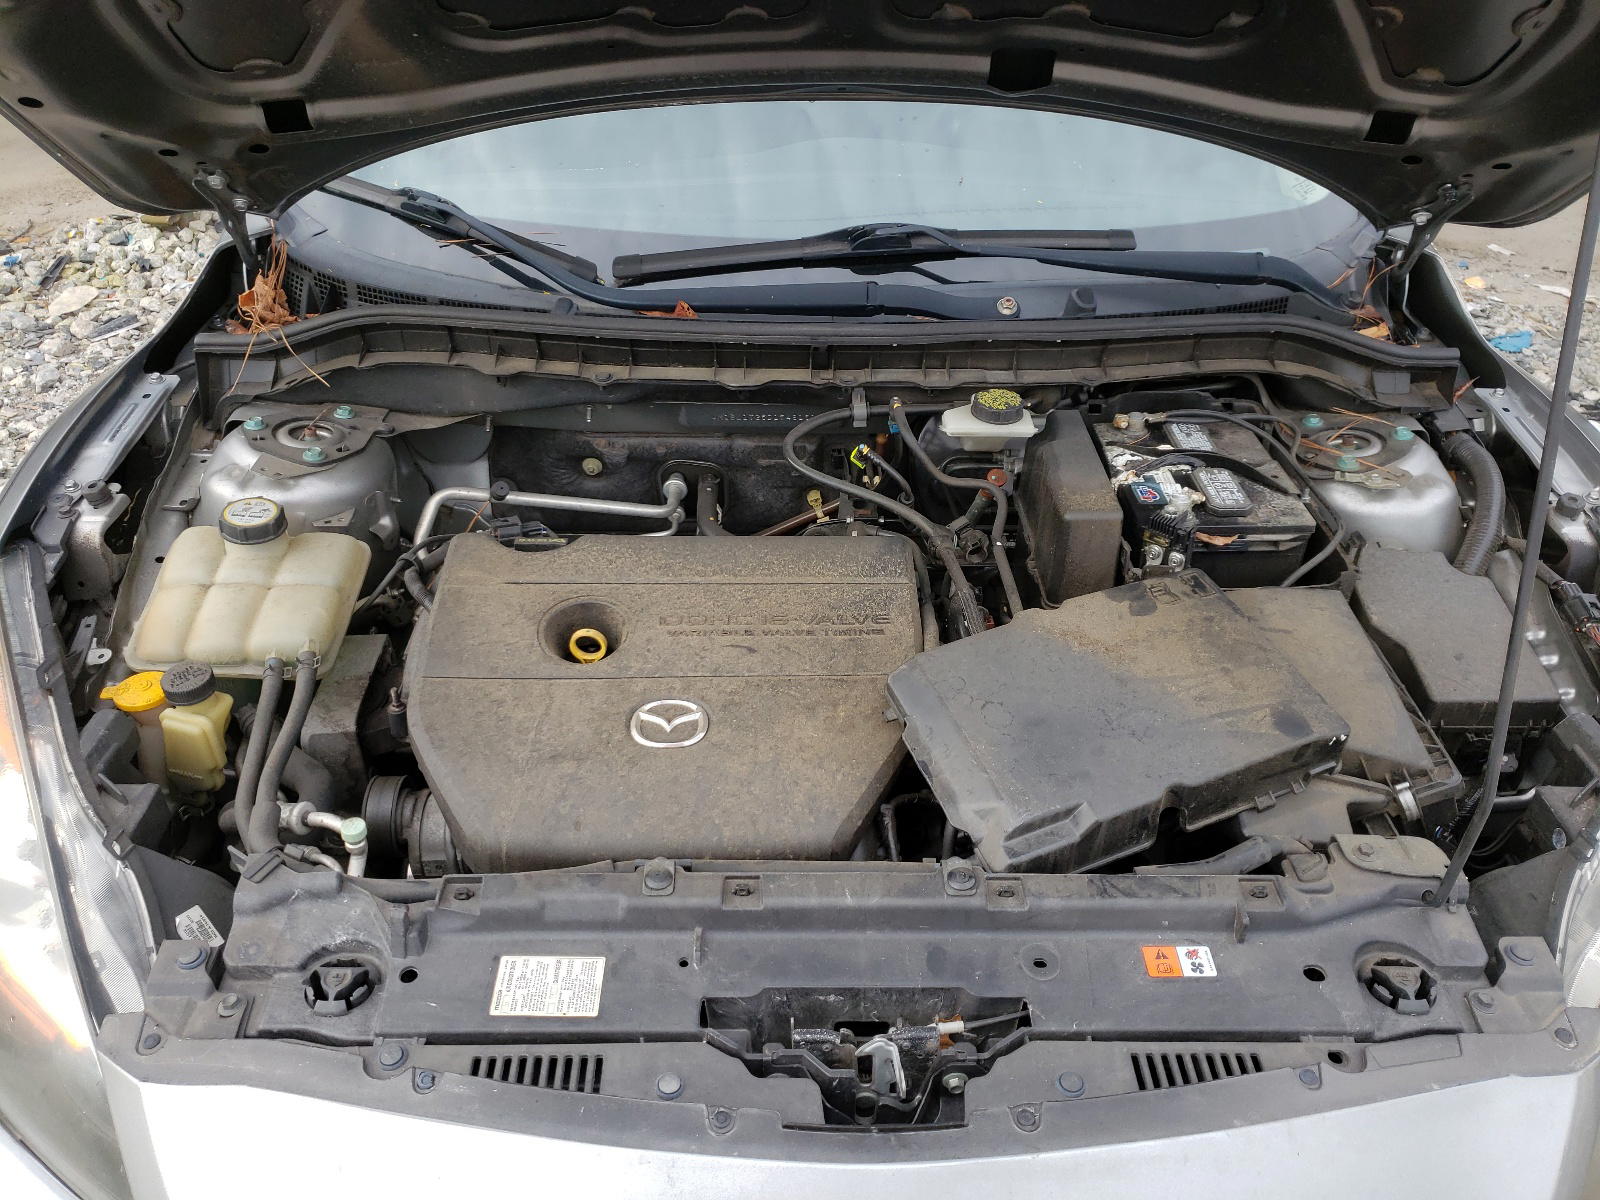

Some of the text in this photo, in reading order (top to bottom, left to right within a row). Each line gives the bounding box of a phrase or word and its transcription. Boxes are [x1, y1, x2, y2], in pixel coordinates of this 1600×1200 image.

[658, 614, 753, 626] DOHC
[666, 628, 886, 637] VARIABLE VALVE TIMING
[494, 989, 503, 1011] mazda
